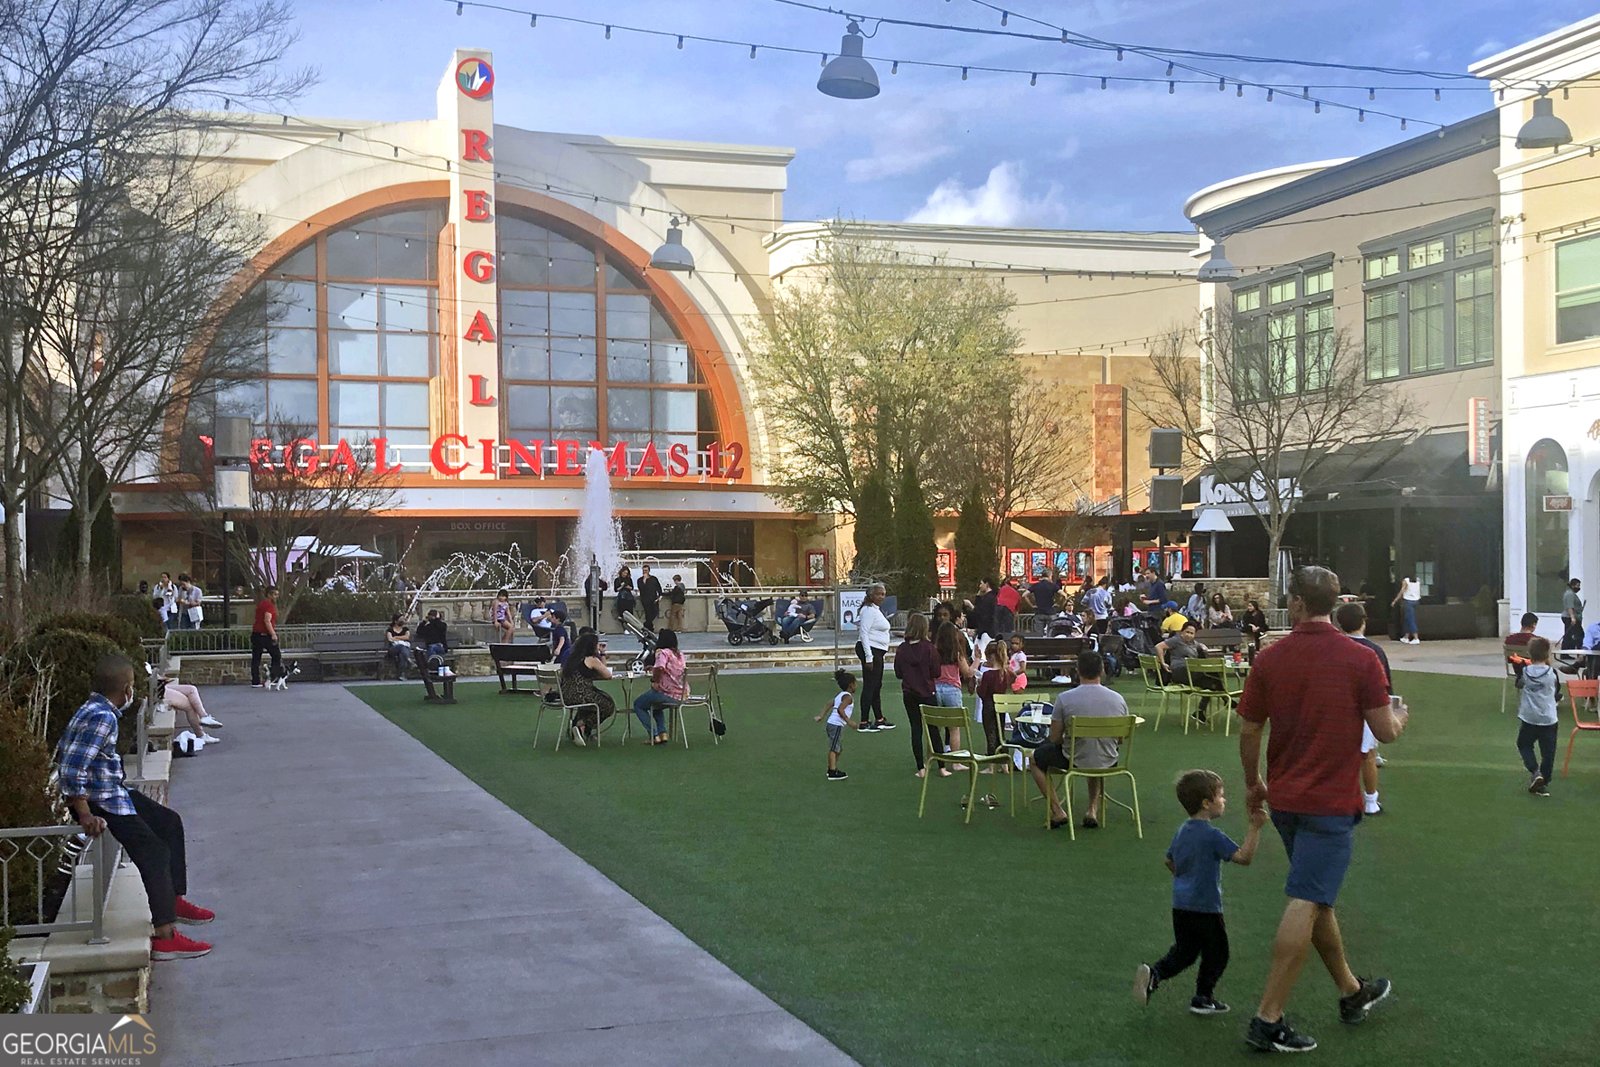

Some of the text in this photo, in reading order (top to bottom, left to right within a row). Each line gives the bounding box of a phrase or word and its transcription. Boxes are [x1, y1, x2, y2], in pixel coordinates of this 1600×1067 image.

[461, 129, 496, 406] REGAL
[199, 434, 402, 477] EGAL
[706, 441, 745, 479] 12
[450, 522, 506, 530] BOX OFFICE
[842, 599, 863, 608] MAS
